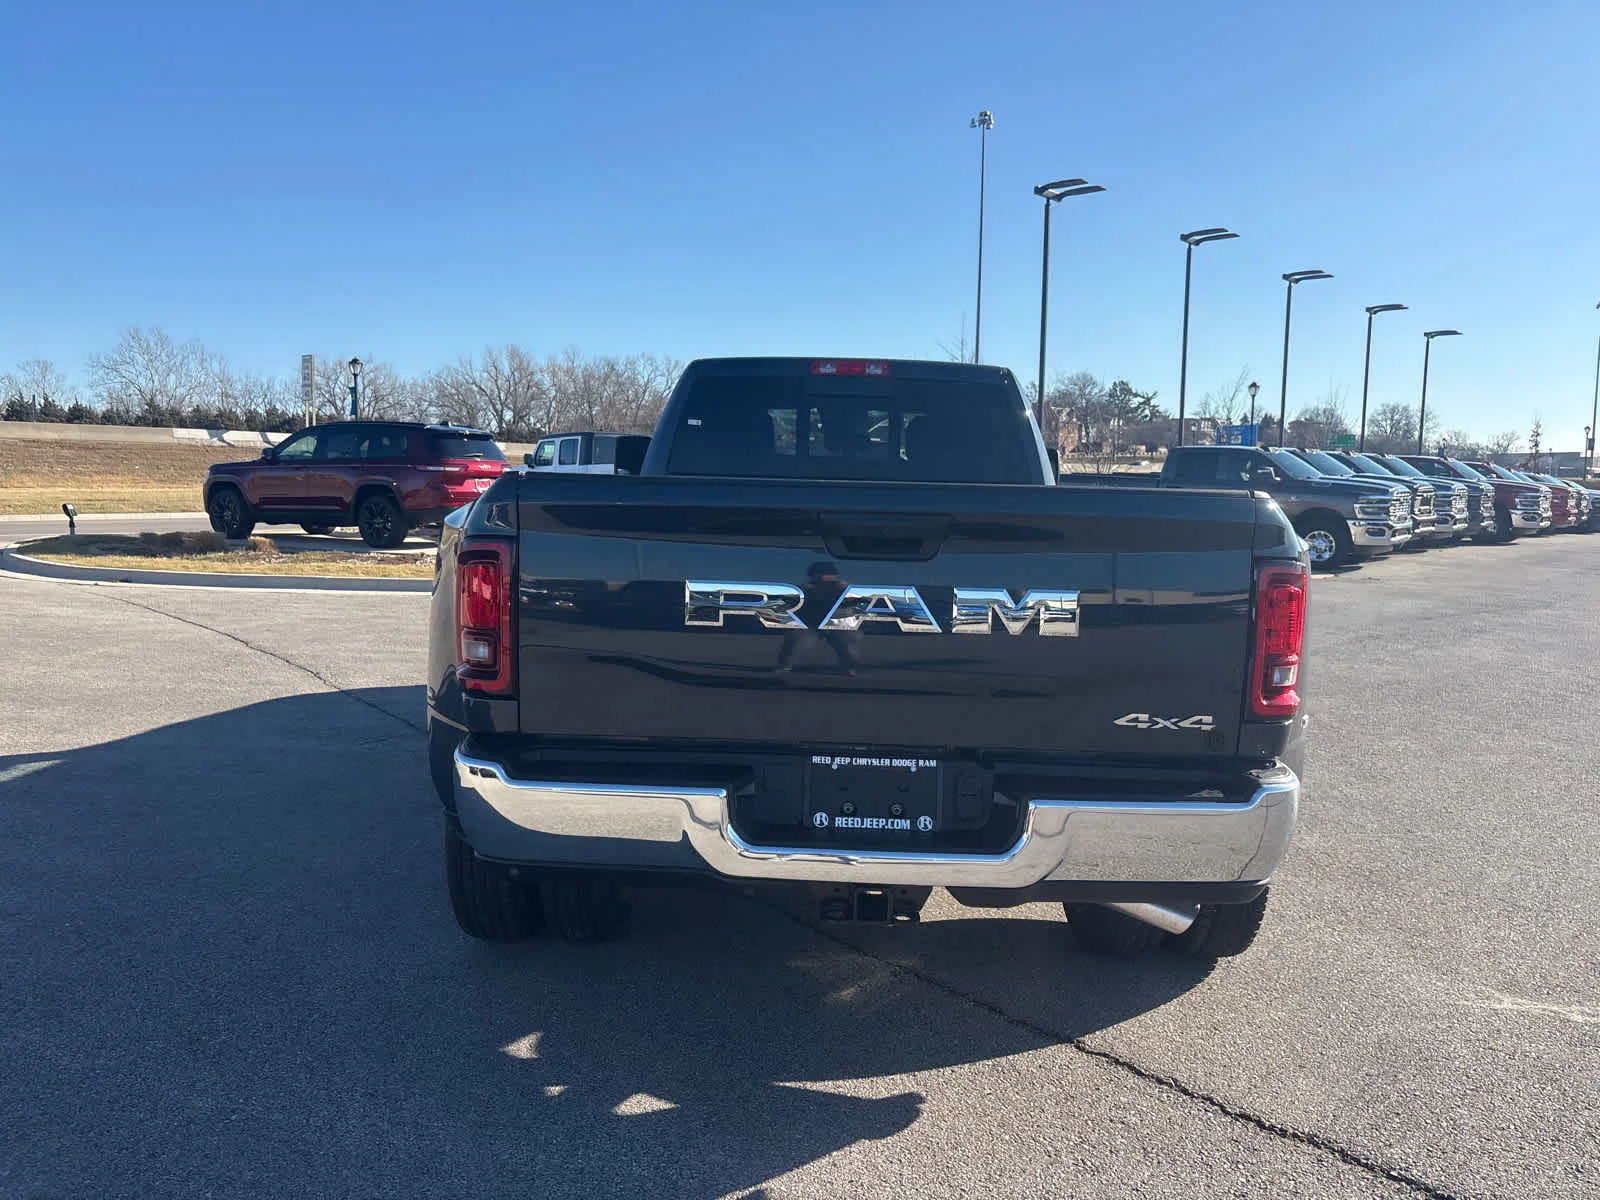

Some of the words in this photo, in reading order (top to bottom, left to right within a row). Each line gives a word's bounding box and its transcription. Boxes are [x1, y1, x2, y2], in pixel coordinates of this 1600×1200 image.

[684, 580, 1080, 637] RAM
[1113, 713, 1216, 731] 4x4
[812, 755, 831, 764] REED
[833, 757, 851, 765] JEEP
[852, 757, 890, 767] CHRYSLER
[891, 758, 917, 767] DODGE
[918, 759, 937, 768] RAM
[835, 816, 911, 830] REEDJEEP.COM
